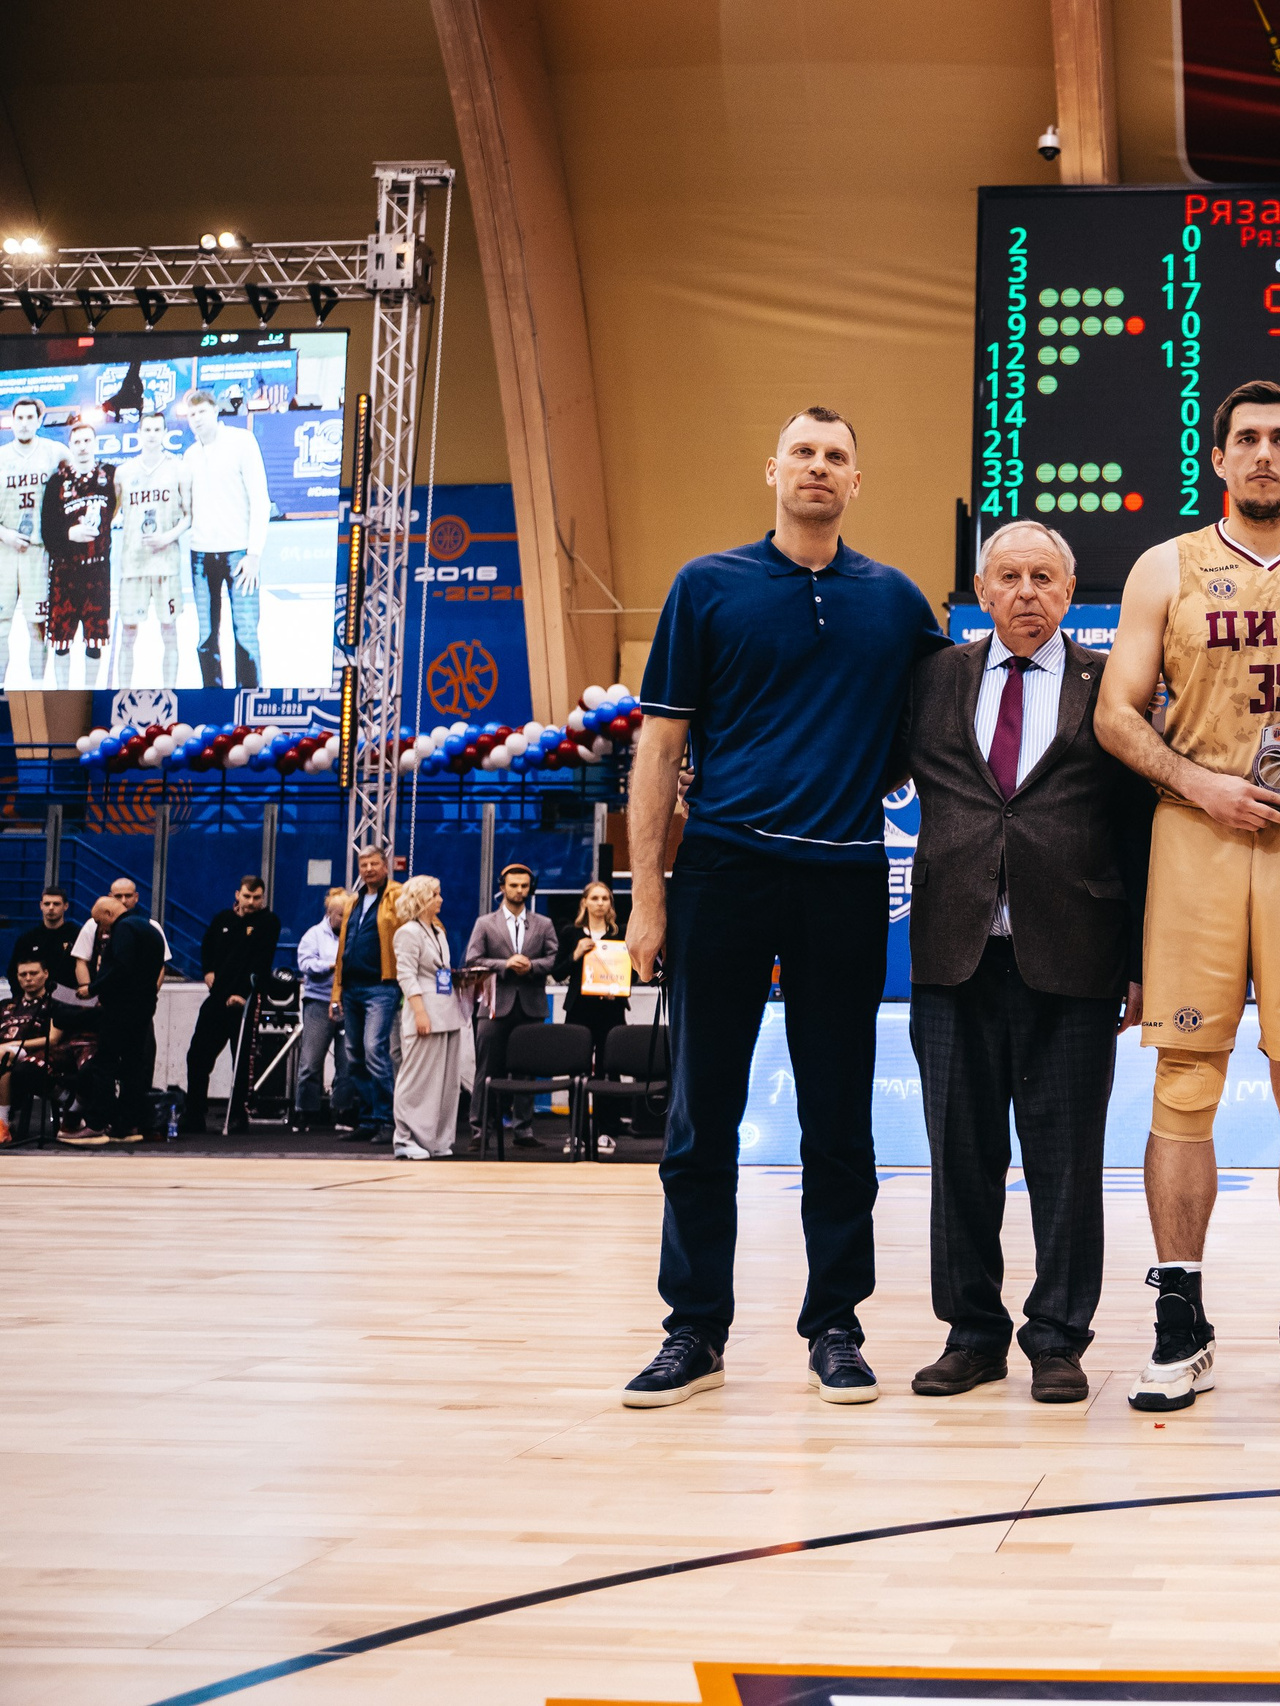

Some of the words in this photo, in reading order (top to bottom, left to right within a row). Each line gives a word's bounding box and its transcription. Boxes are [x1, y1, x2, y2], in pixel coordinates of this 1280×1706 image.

[1009, 227, 1027, 254] 2
[1183, 225, 1201, 252] 0
[1008, 256, 1027, 283] 3
[1162, 254, 1195, 281] 11
[1008, 284, 1026, 311] 5
[1162, 282, 1201, 309] 17
[1008, 313, 1026, 340] 9
[1182, 311, 1200, 338] 0
[987, 342, 1025, 369] 12
[1161, 340, 1200, 368] 13
[987, 371, 1025, 399] 13
[1181, 369, 1200, 397] 2
[986, 400, 1026, 428] 14
[1181, 399, 1200, 426] 0
[983, 430, 1019, 458] 21
[1181, 428, 1199, 456] 0
[7, 473, 48, 489] ЦИВС
[982, 459, 1023, 487] 33
[1181, 458, 1199, 485] 9
[18, 492, 36, 510] 35
[130, 489, 171, 506] ЦИВС
[981, 489, 1018, 517] 41
[1180, 487, 1199, 515] 2
[414, 565, 498, 582] 2016
